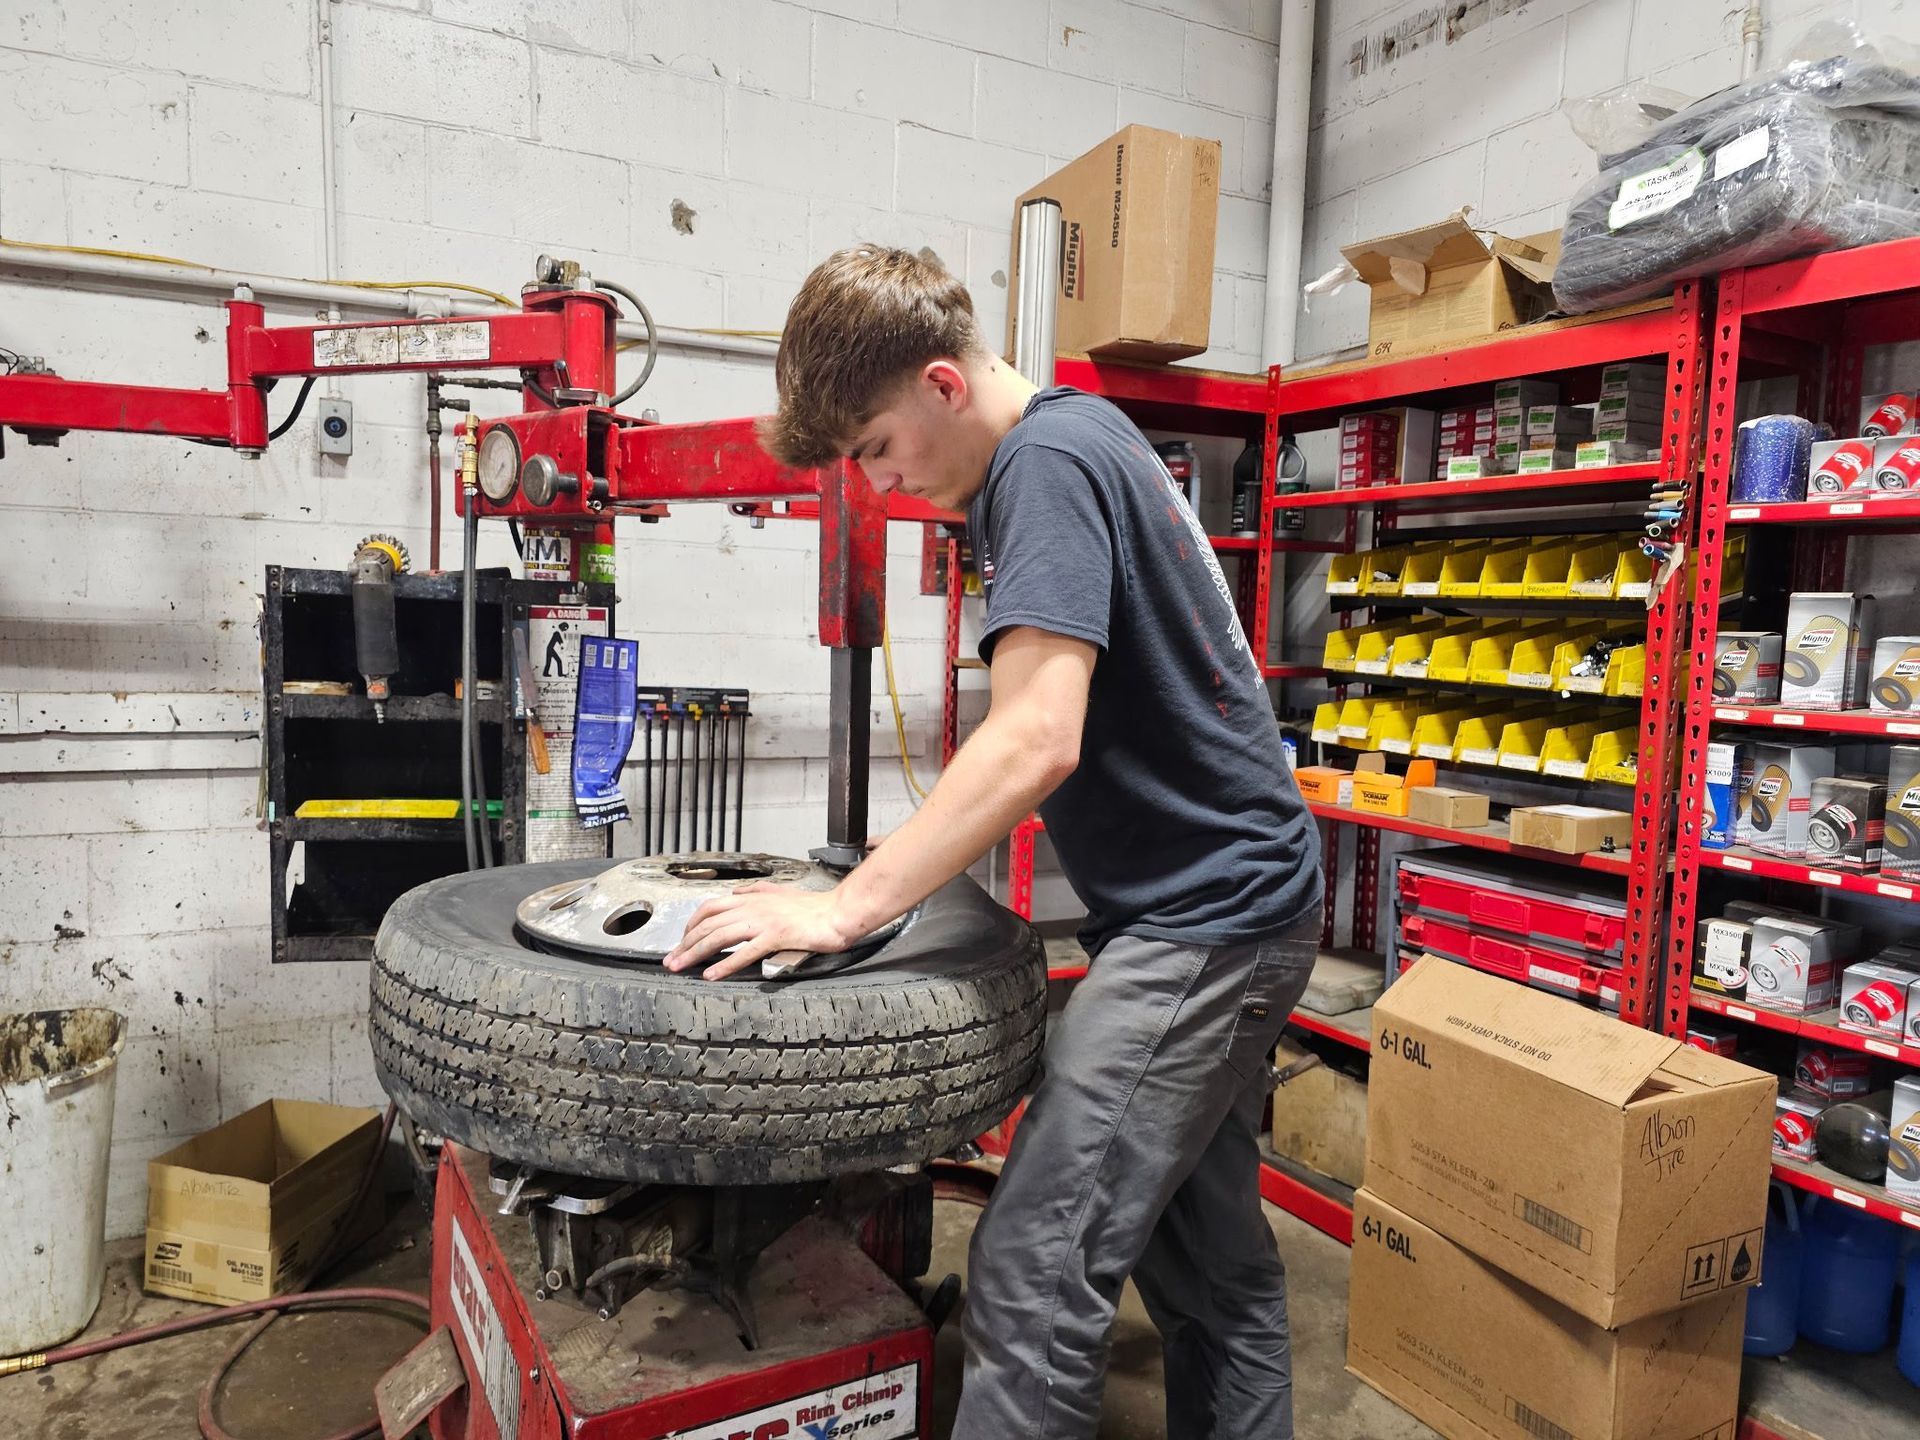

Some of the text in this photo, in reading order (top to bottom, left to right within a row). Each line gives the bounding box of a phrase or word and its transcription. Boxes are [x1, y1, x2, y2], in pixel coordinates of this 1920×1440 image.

[1647, 162, 1688, 187] TASK Brand
[1111, 190, 1122, 248] M24580
[1065, 222, 1081, 299] Mighty
[1802, 634, 1832, 644] Mighty
[1723, 654, 1746, 664] Mighty
[1299, 779, 1321, 788] DORMAN
[1761, 782, 1780, 792] Mighty
[1362, 790, 1390, 800] DORMAN
[1712, 928, 1742, 939] MX3500
[1445, 1014, 1466, 1028] HIGH
[1471, 1024, 1494, 1041] OVER
[1494, 1032, 1520, 1050] STACK
[1380, 1028, 1432, 1070] 6-1 GAL.
[1520, 1042, 1537, 1056] NOT
[1538, 1050, 1552, 1062] DO
[1639, 1109, 1696, 1159] Albion
[1431, 1147, 1449, 1164] STA
[1449, 1157, 1478, 1181] KLEEN
[1644, 1144, 1689, 1183] Tire
[1363, 1216, 1417, 1263] 6-1 GAL.
[158, 1245, 180, 1257] Mighty
[240, 1262, 264, 1271] FILTER
[1418, 1339, 1437, 1358] STA
[1437, 1349, 1467, 1377] KLEEN
[796, 1382, 904, 1426] Rim Clamp
[826, 1408, 896, 1439] series
